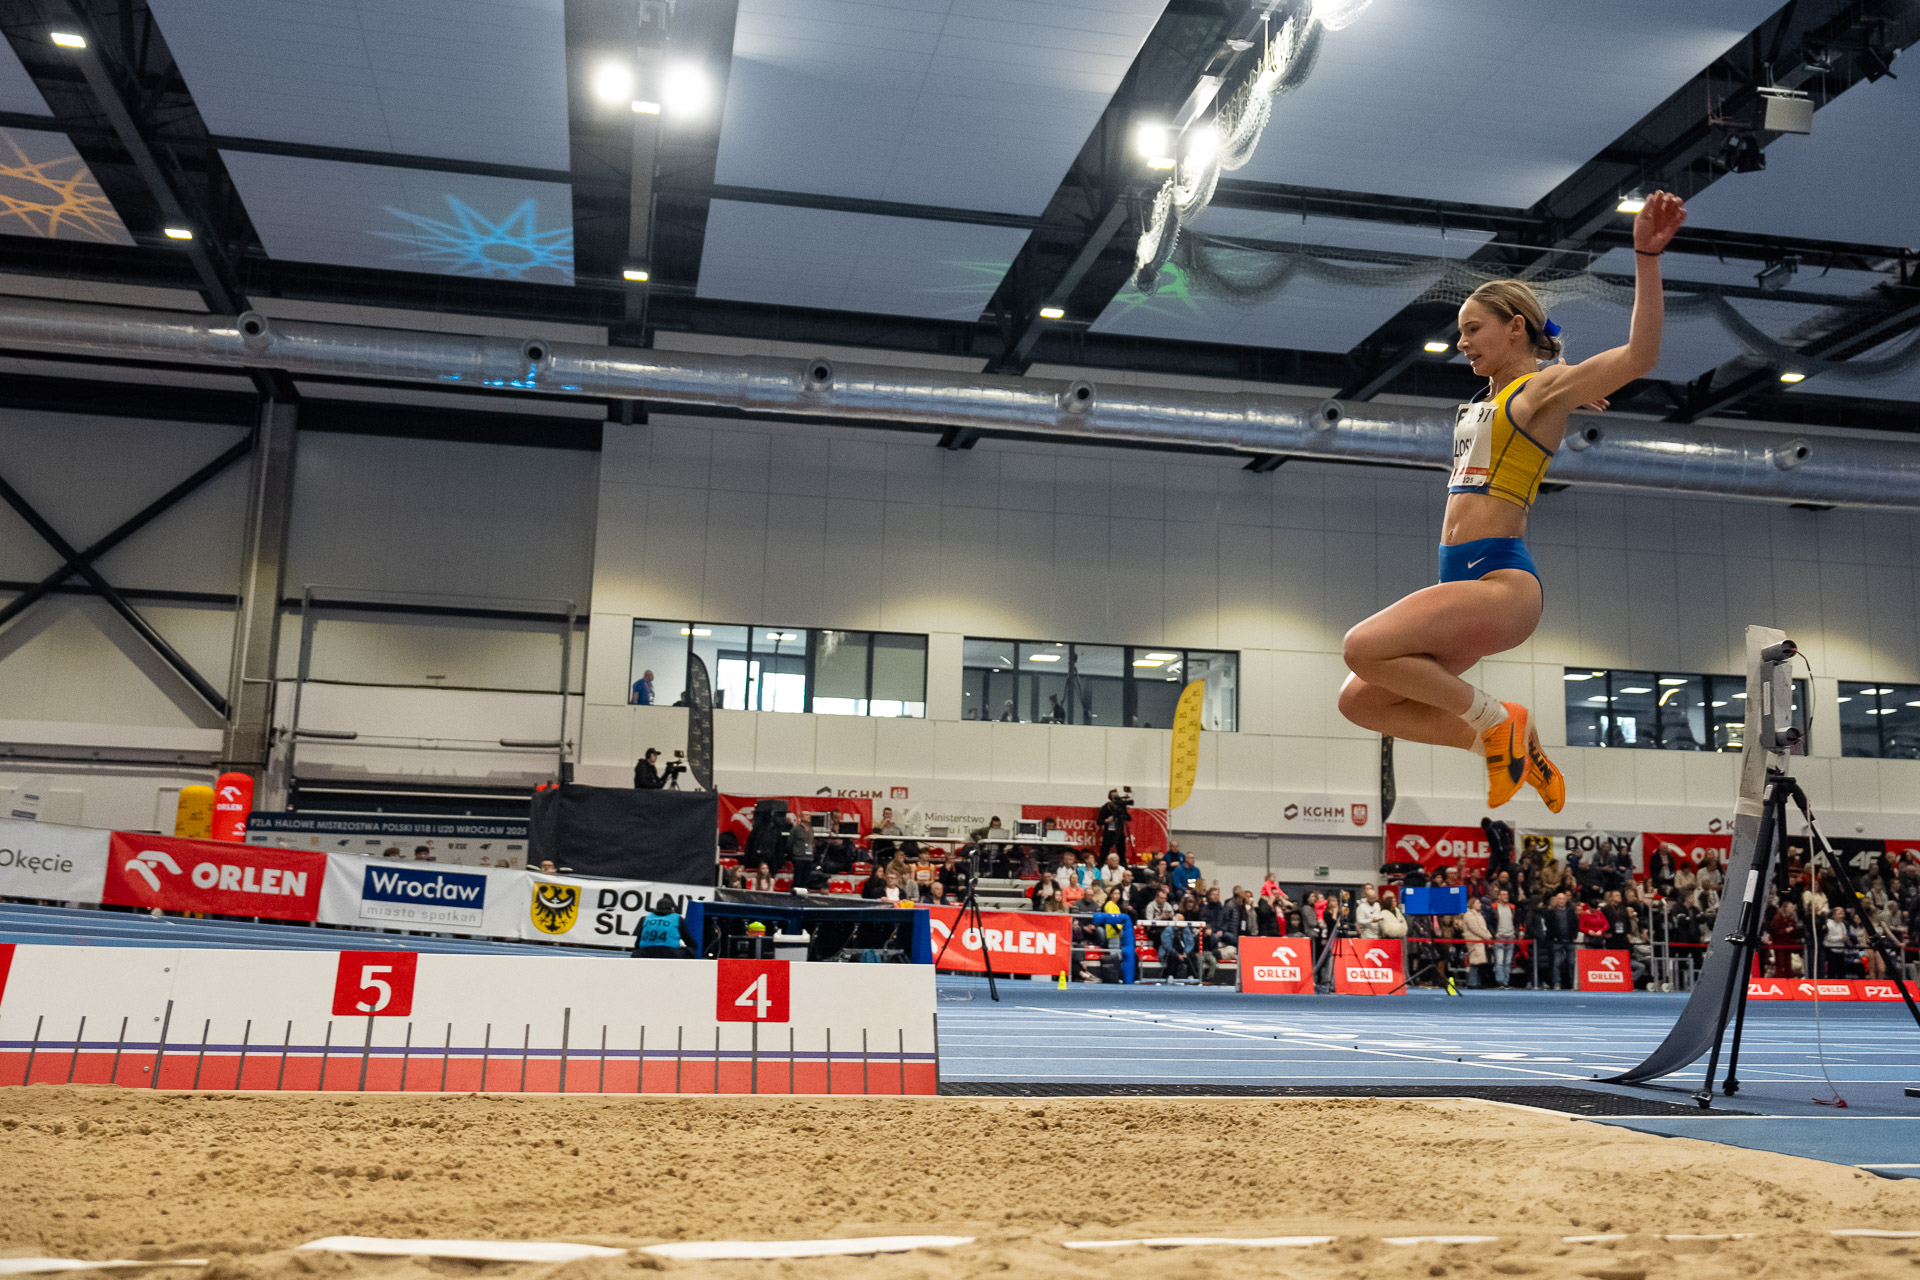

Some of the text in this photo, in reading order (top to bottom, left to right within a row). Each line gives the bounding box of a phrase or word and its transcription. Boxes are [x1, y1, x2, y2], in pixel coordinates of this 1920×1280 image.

[925, 812, 985, 824] Ministerstwo
[1303, 806, 1345, 817] KGHM
[250, 818, 272, 828] PZLA
[275, 819, 315, 829] HALOWE
[316, 821, 380, 831] MISTRZOSTWA
[381, 822, 413, 832] POLSKI
[414, 823, 431, 832] U18
[437, 825, 455, 833] U20
[506, 826, 527, 835] 2025
[0, 848, 73, 874] Okęcie
[191, 862, 307, 897] ORLEN
[371, 870, 480, 901] Wrocław
[367, 905, 476, 922] miasto spotkań
[962, 927, 1056, 955] ORLEN
[1257, 969, 1297, 978] ORLEN
[1350, 970, 1389, 980] ORLEN
[356, 965, 392, 1012] 5
[734, 973, 772, 1018] 4
